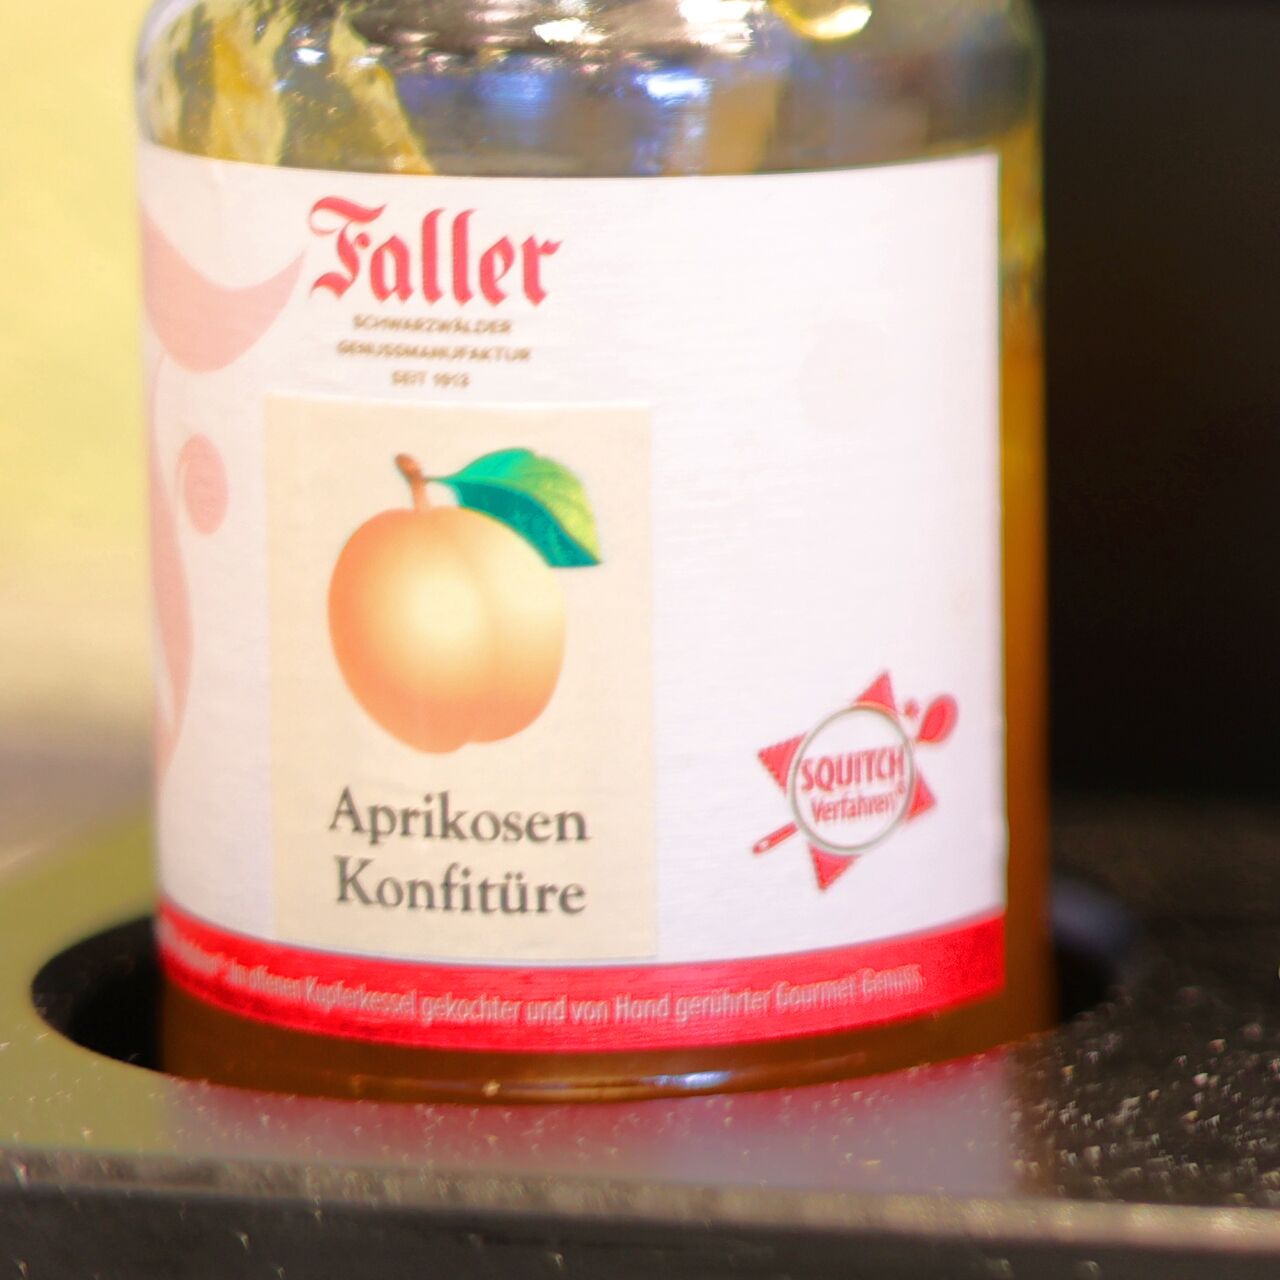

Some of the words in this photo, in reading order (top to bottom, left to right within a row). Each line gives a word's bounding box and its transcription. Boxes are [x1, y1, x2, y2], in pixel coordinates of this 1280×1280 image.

[308, 195, 563, 306] Faller
[390, 370, 426, 386] SEIT
[801, 744, 905, 792] SQUITCH
[328, 784, 593, 846] Aprikosen
[333, 854, 588, 915] Konfitüre
[304, 974, 418, 1021] Kupferkessel
[421, 992, 521, 1029] gekochter
[526, 993, 566, 1026] und
[569, 998, 610, 1027] von
[614, 992, 671, 1024] Hand
[674, 985, 774, 1025] gerührter
